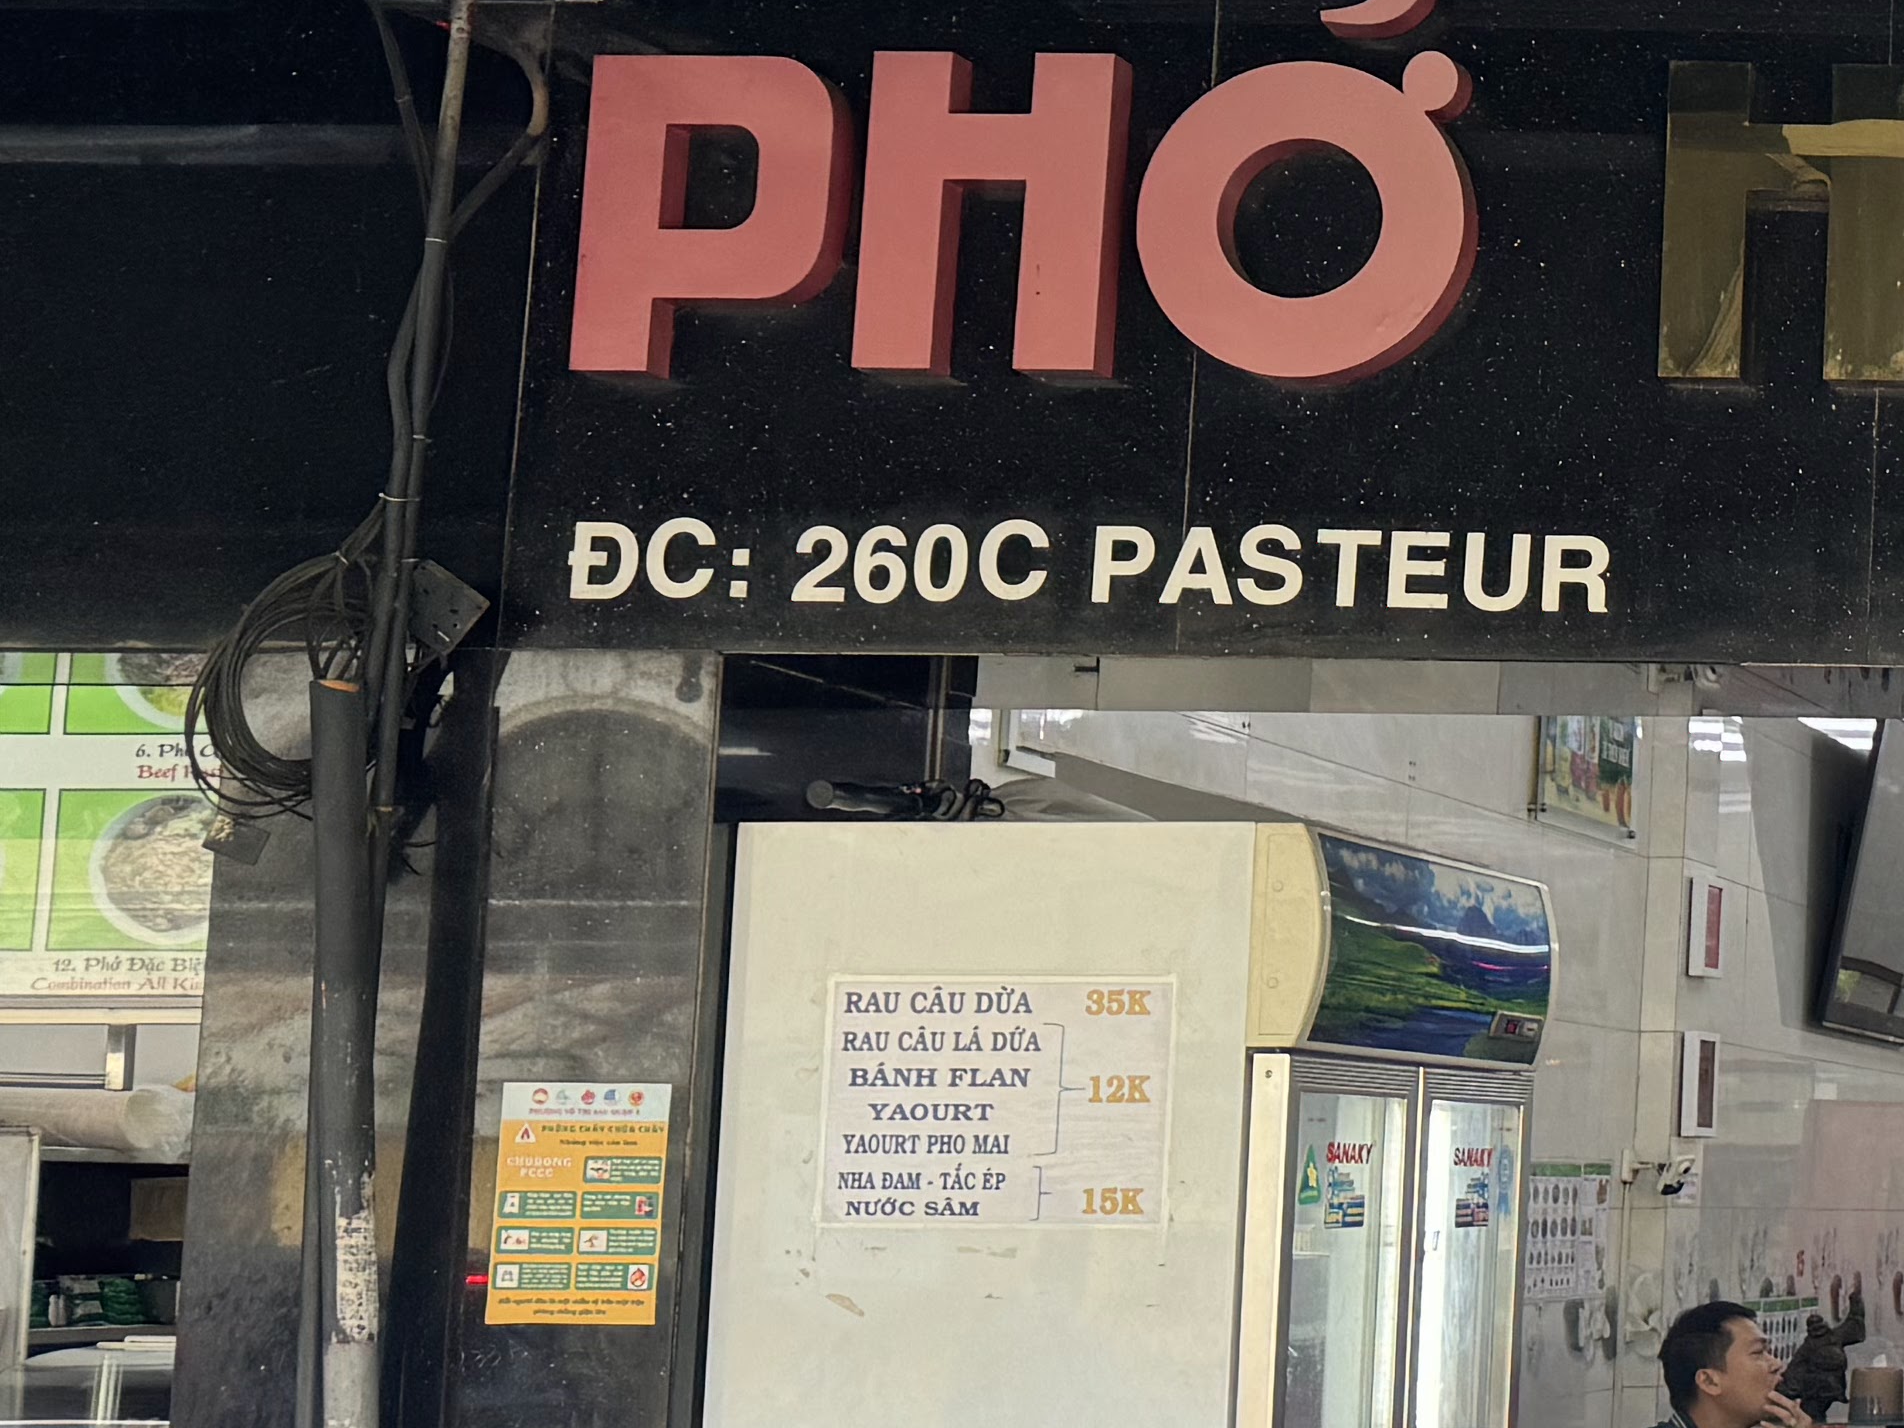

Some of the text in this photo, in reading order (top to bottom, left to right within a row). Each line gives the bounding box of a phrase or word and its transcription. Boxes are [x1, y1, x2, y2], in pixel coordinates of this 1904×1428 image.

[568, 518, 1612, 614] ĐC: 260C PASTEUR
[136, 744, 151, 758] 6.
[159, 743, 194, 757] Ph
[137, 764, 180, 782] Beef
[84, 955, 121, 972] Phở
[844, 992, 901, 1014] RAU
[910, 987, 966, 1014] CÂU
[1085, 989, 1152, 1016] 35K
[842, 1031, 889, 1052] RAU
[898, 1026, 945, 1052] CÂU
[952, 1025, 984, 1052] LÁ
[848, 1063, 1031, 1087] BÁNH FLAN
[1088, 1075, 1151, 1104] 12K
[867, 1103, 994, 1121] YAOURT
[842, 1134, 1010, 1155] YAOURT PHO MAI
[1326, 1141, 1373, 1164] SANAKY
[837, 1171, 875, 1191] NHA
[881, 1172, 921, 1191] ĐAM
[982, 1166, 1006, 1191] ÉP
[845, 1196, 980, 1217] NƯỚC SÂM
[1082, 1187, 1144, 1215] 15K
